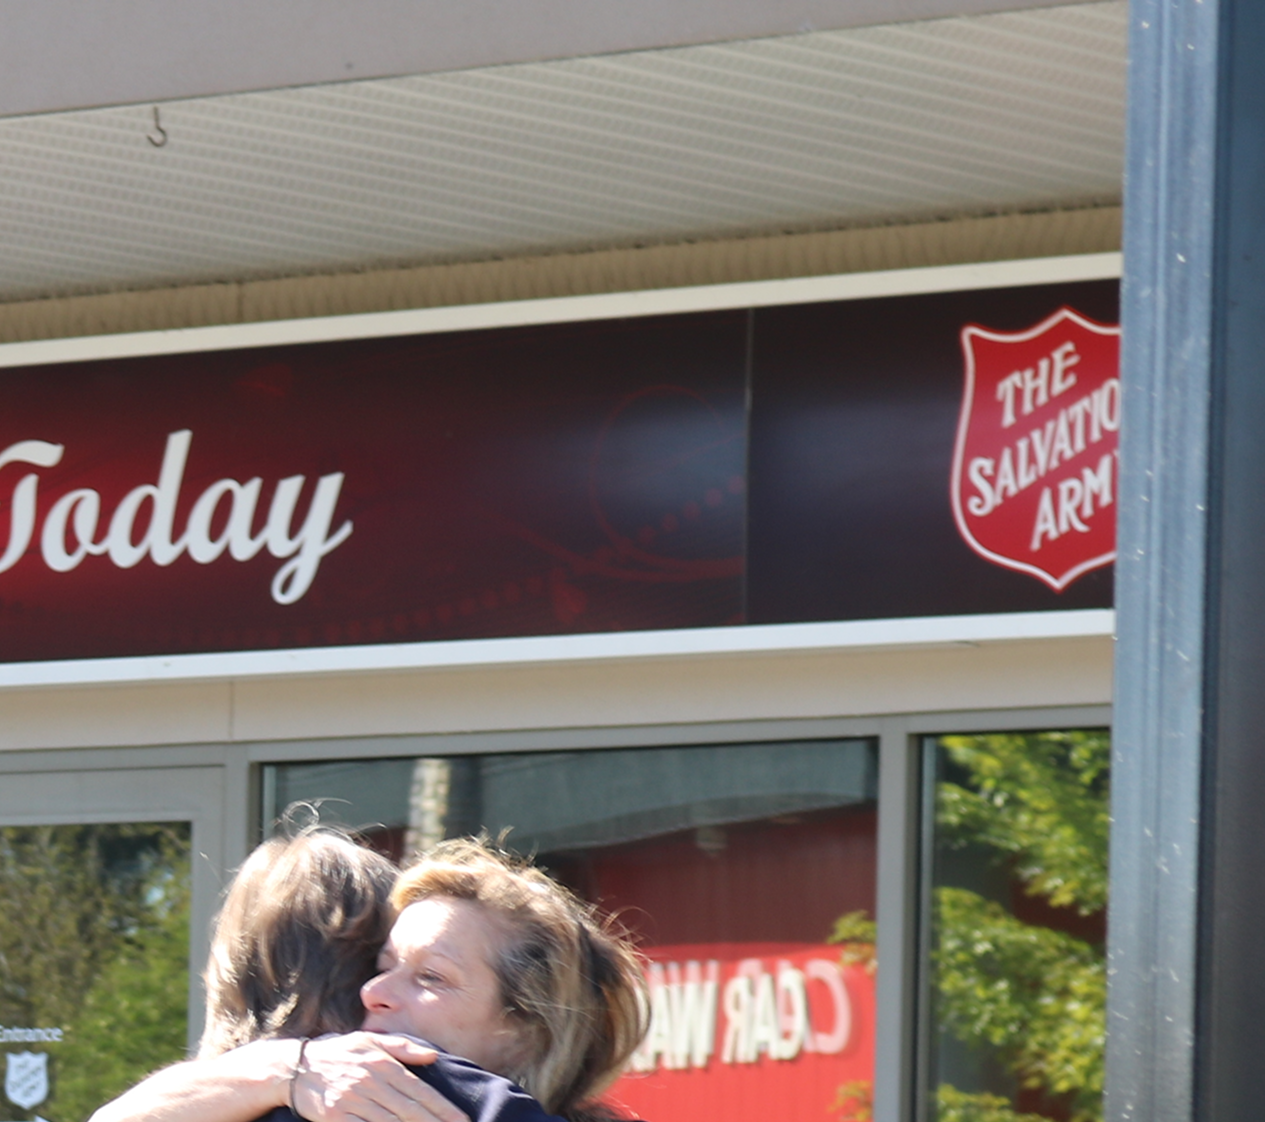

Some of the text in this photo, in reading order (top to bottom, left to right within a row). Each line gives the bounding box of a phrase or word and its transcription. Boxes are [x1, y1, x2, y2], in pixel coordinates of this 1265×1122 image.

[996, 341, 1081, 428] THE
[967, 378, 1120, 516] SALVATIO
[1030, 450, 1119, 552] ARM
